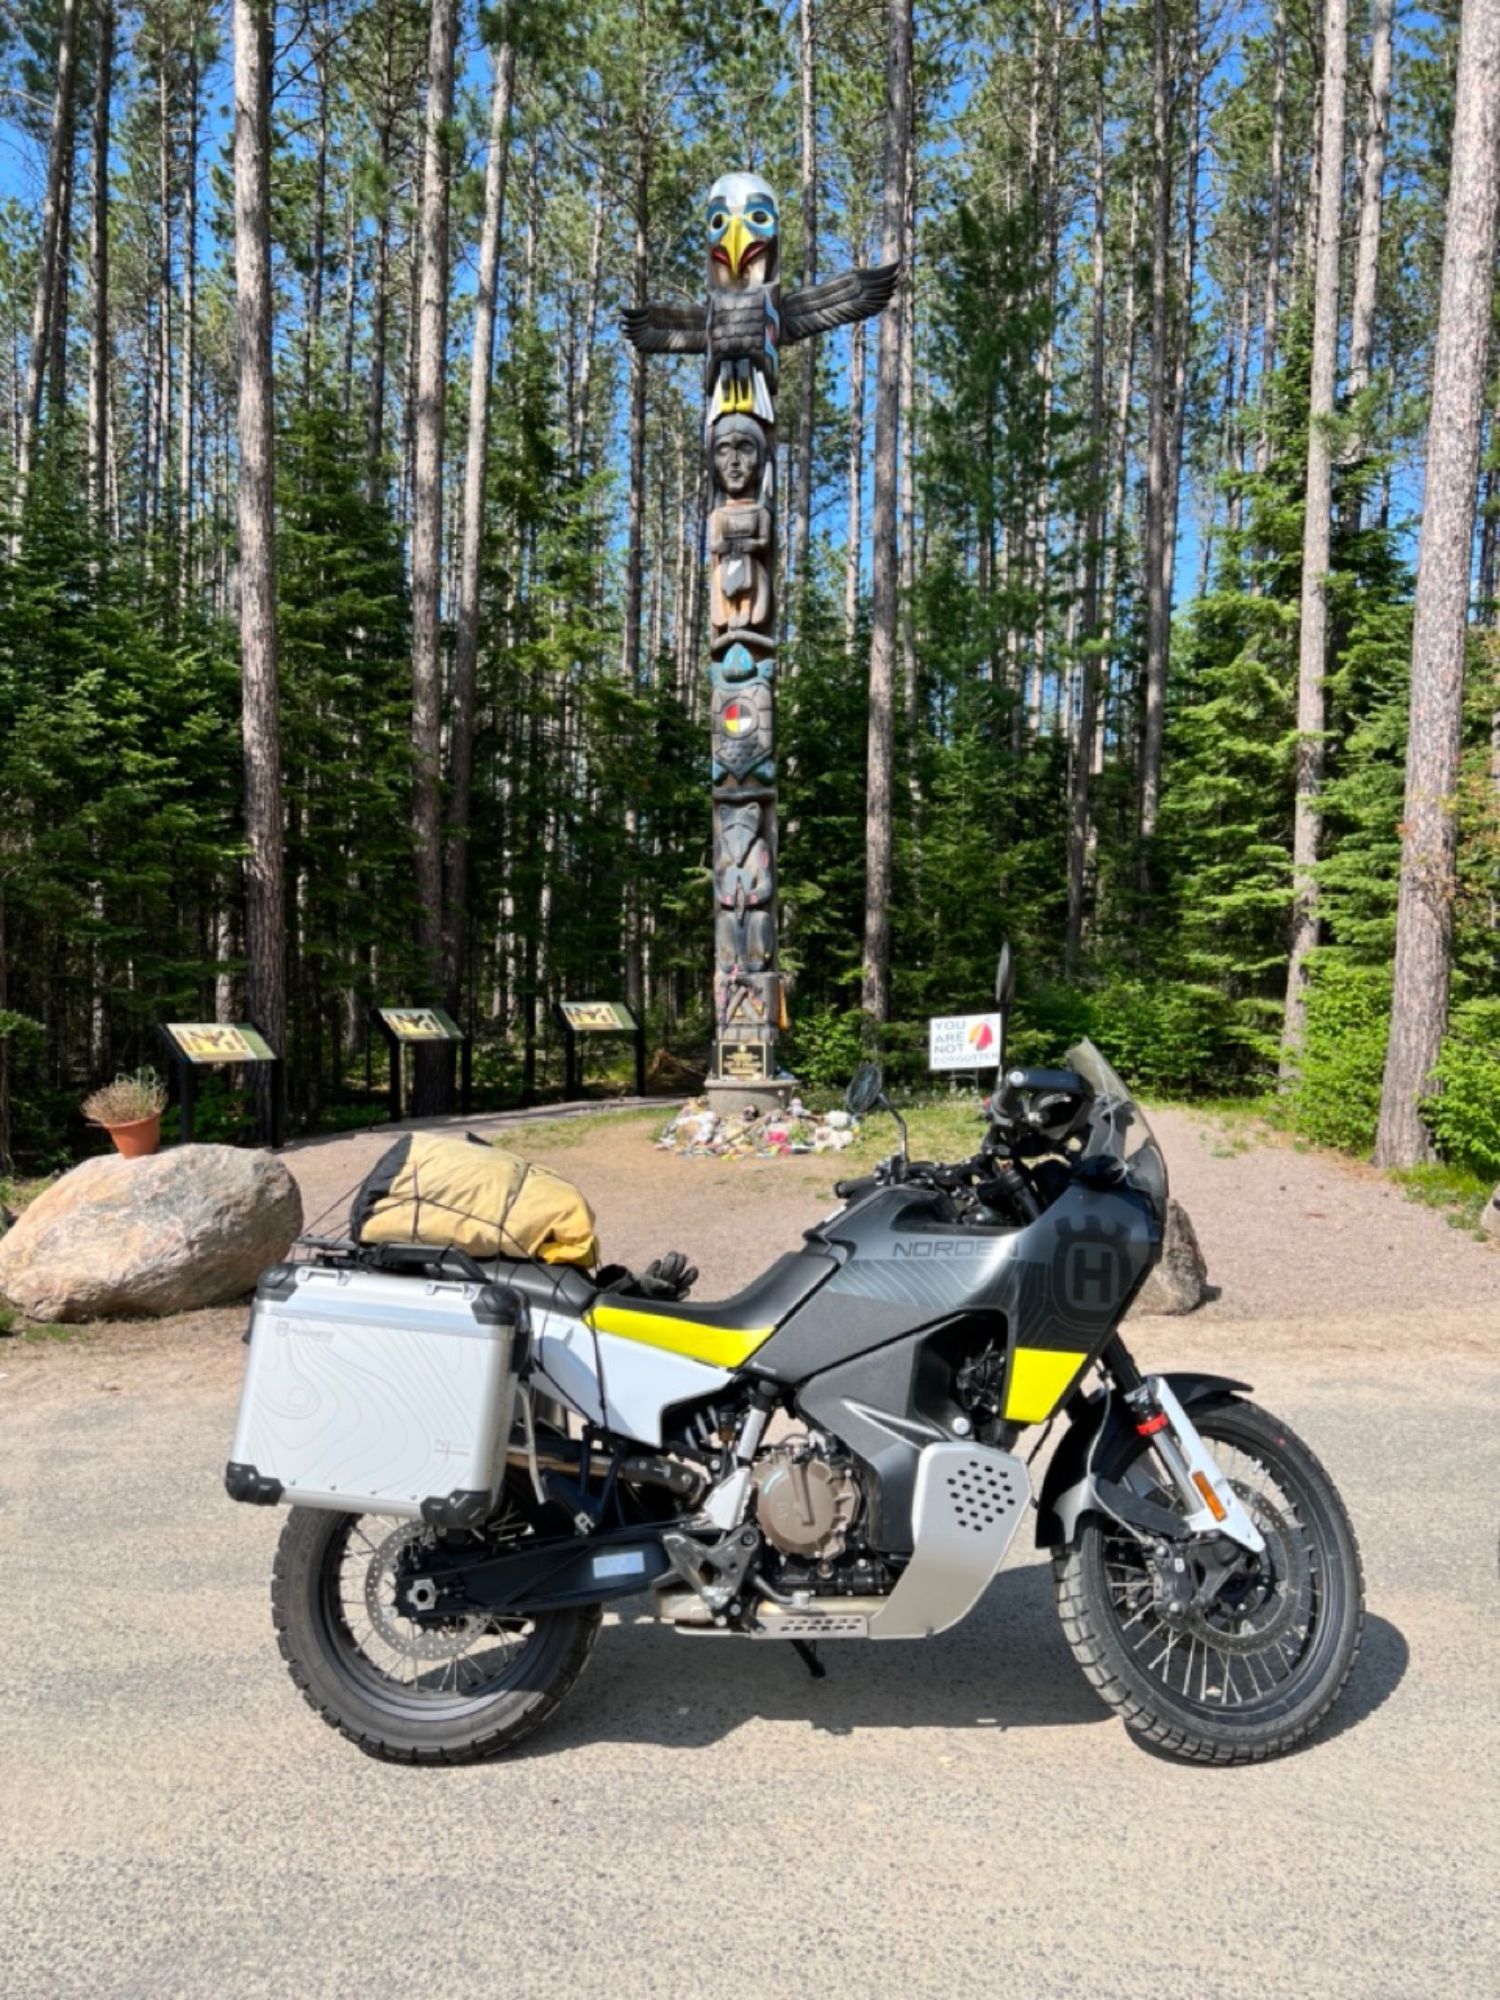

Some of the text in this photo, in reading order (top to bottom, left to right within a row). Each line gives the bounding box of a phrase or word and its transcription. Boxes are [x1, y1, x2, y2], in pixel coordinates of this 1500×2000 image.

[935, 1020, 966, 1030] YOU
[935, 1031, 964, 1043] ARE
[934, 1043, 964, 1053] NOT
